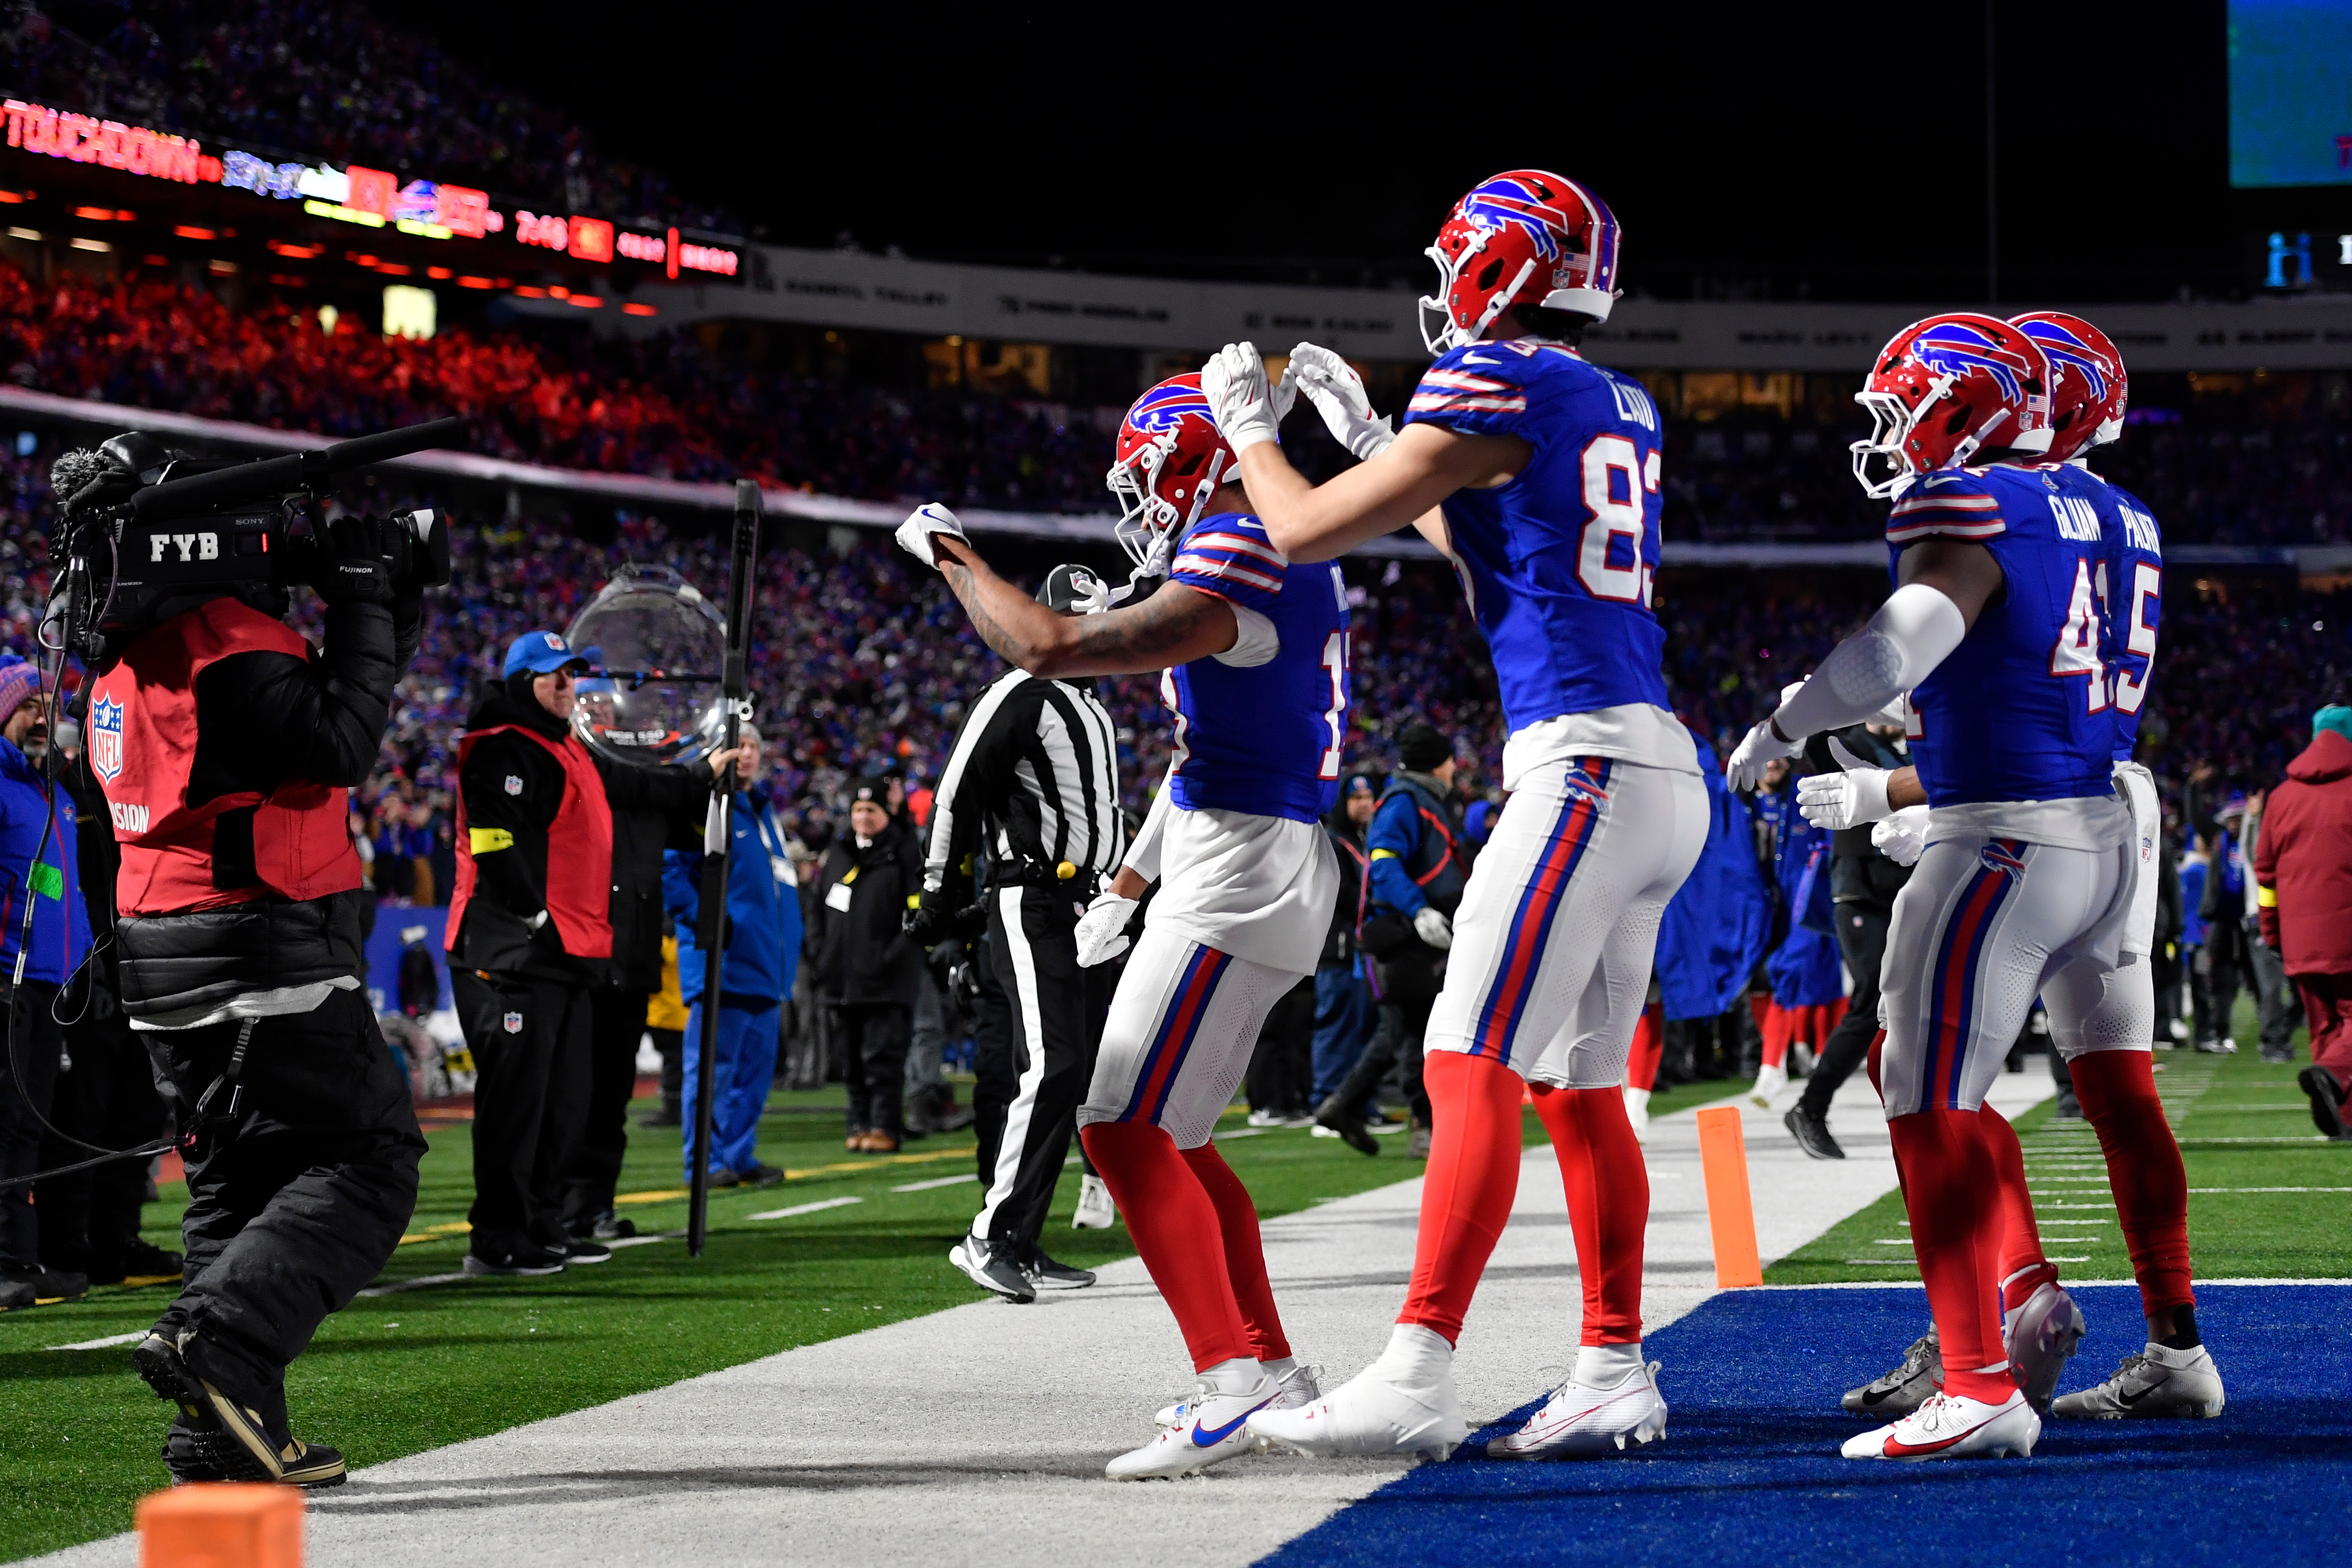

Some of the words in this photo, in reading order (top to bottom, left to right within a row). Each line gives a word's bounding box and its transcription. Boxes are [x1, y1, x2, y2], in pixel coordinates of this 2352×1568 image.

[3, 99, 201, 184] TOUCHDOWN
[2048, 495, 2102, 542] GILLIAM
[150, 532, 218, 562] FYB
[96, 731, 120, 771] NFL
